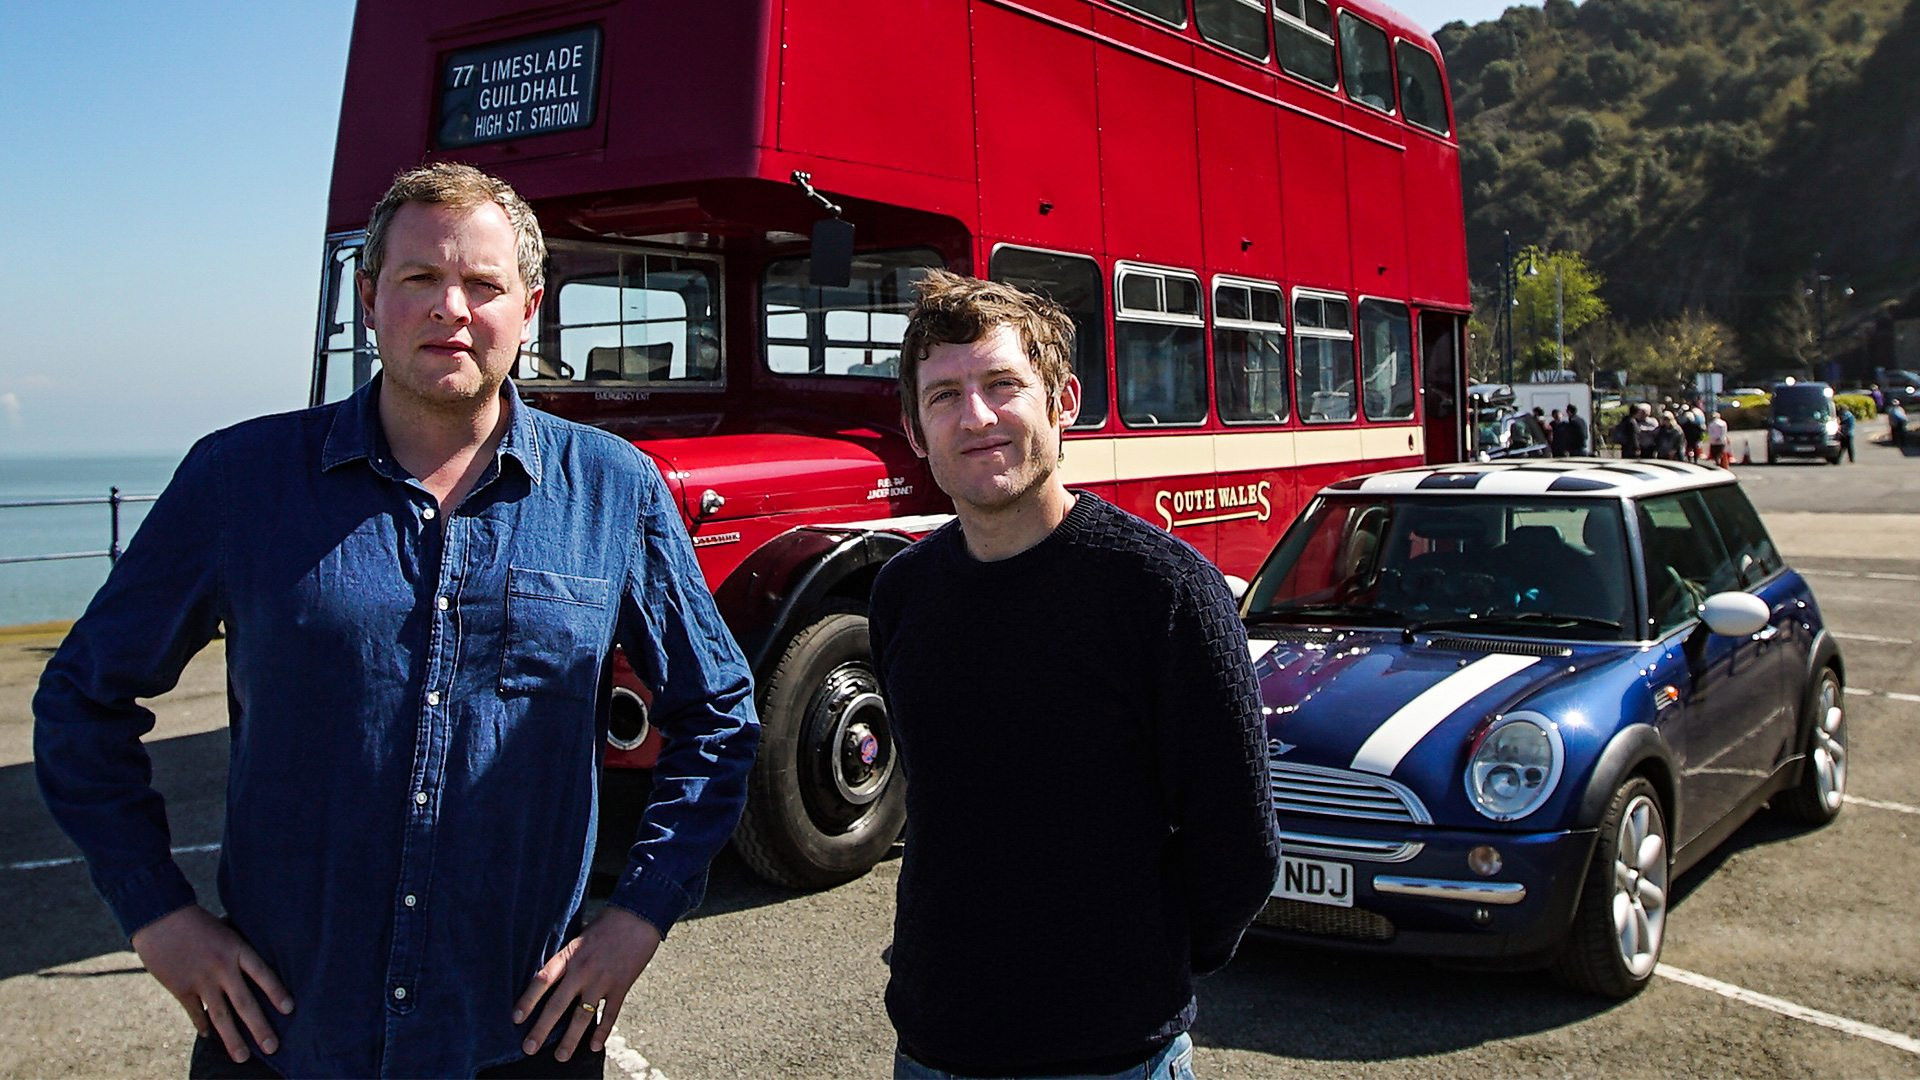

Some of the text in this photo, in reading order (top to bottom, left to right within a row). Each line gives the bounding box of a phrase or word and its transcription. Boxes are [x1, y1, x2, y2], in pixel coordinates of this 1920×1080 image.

[452, 45, 584, 88] 77 LIMESLADE
[479, 73, 580, 110] GUILDHALL
[474, 101, 580, 138] HIGH ST. STATION
[1155, 480, 1271, 534] SOUTH WALES
[1284, 860, 1348, 899] NDJ
